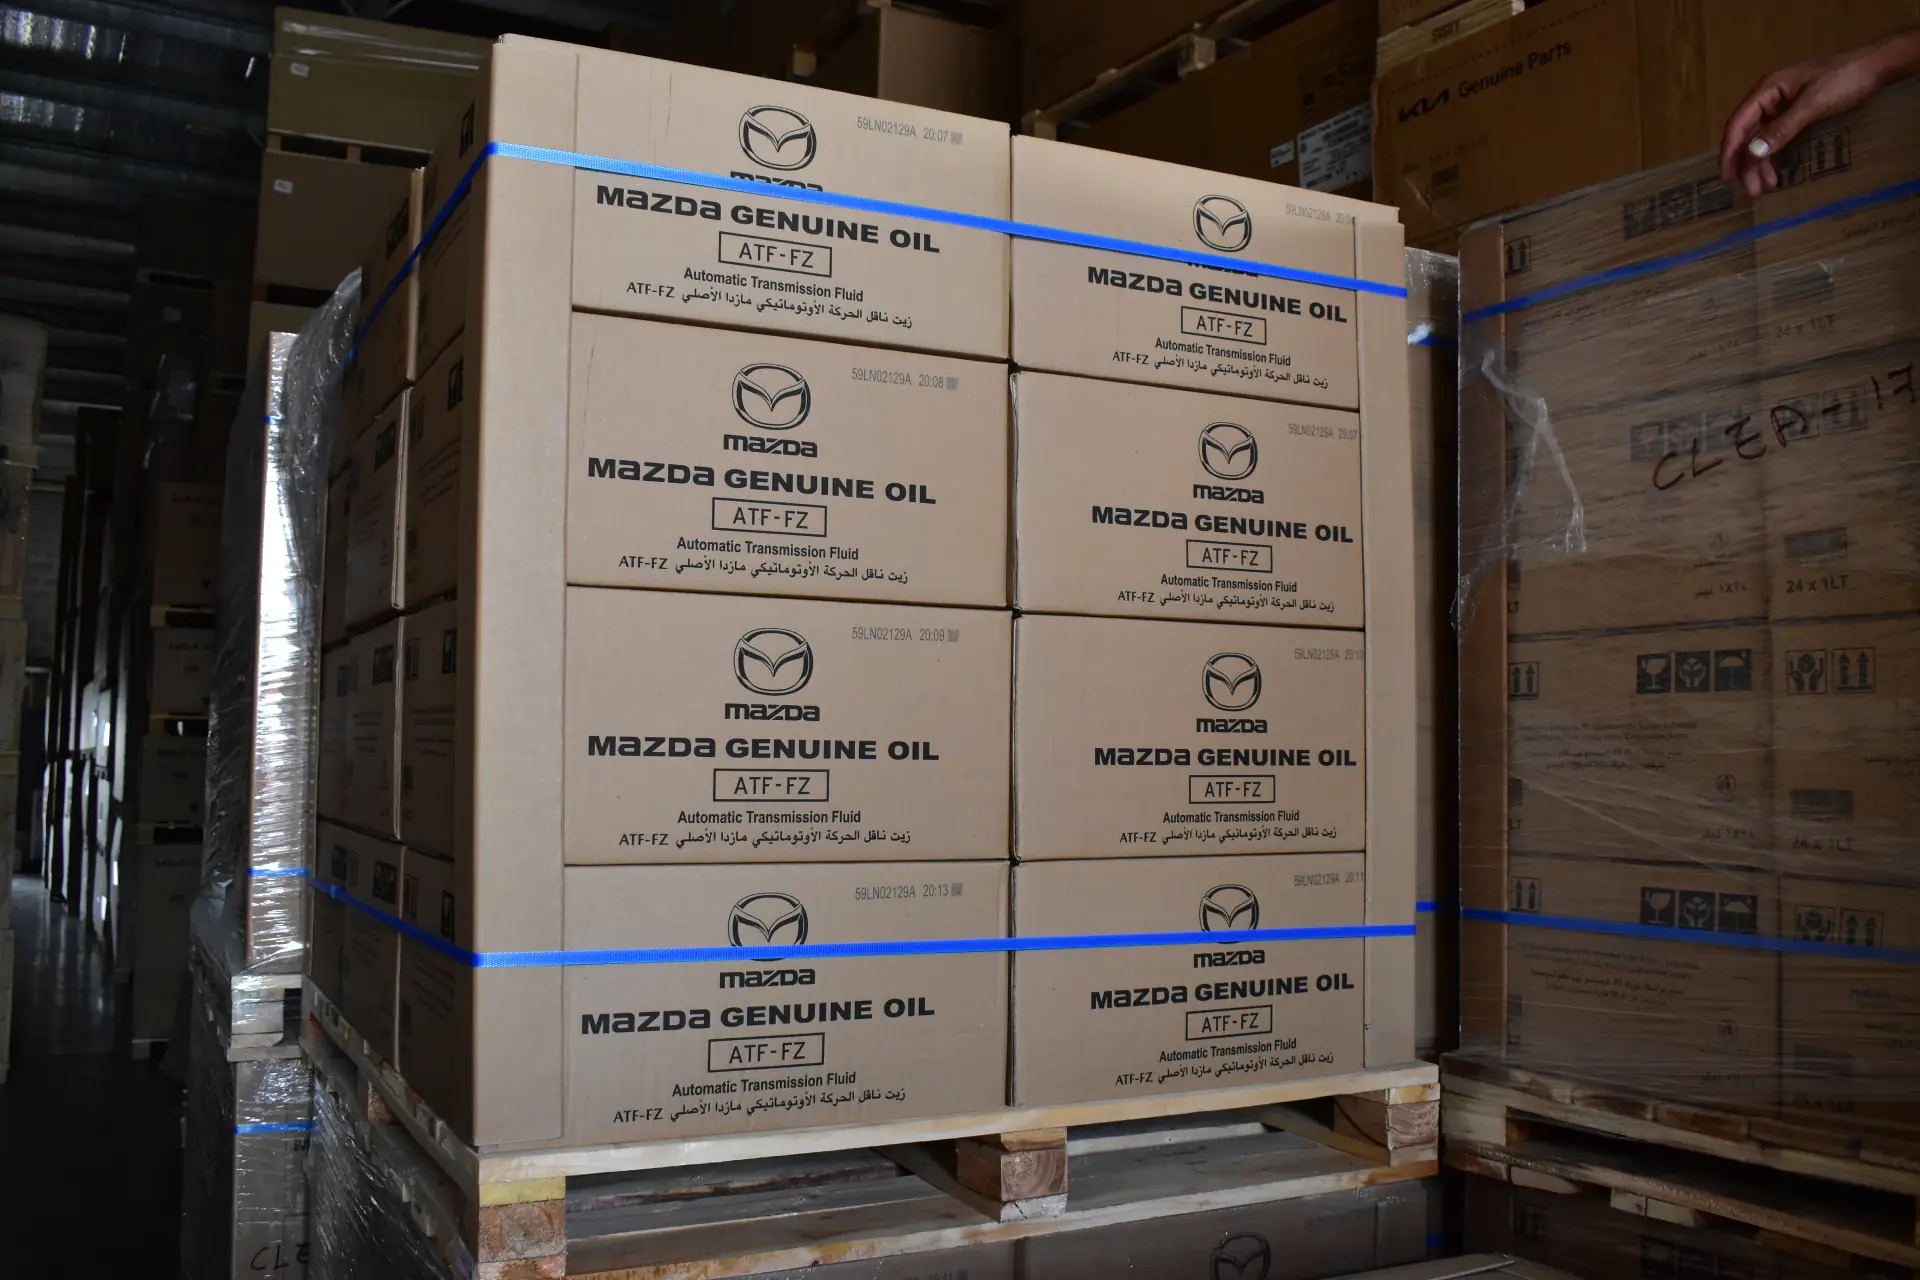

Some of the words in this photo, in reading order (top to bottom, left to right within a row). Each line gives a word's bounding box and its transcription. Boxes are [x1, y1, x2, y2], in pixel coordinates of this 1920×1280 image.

[1458, 62, 1523, 98] Genuine
[1528, 40, 1572, 69] Parts
[857, 116, 917, 138] 59LN02129A
[923, 127, 948, 142] 20:07
[731, 205, 879, 244] GENUINE
[890, 229, 940, 253] OIL
[739, 242, 814, 268] ATF-FZ
[626, 282, 675, 298] ATF-FZ
[684, 267, 747, 287] Automatic
[751, 276, 831, 298] Transmission
[835, 287, 863, 302] Fluid
[682, 286, 721, 304] الأصلي
[726, 292, 752, 307] مازدا
[1189, 283, 1301, 315] GENUINE
[1309, 302, 1347, 323] OIL
[828, 304, 862, 320] الحركة
[866, 311, 888, 323] ناقل
[892, 316, 912, 329] زيت
[1196, 315, 1253, 338] ATF-FZ
[1112, 351, 1149, 365] ATF-FZ
[1155, 337, 1203, 354] Automatic
[1206, 344, 1267, 363] Transmission
[1269, 353, 1291, 366] Fluid
[1154, 354, 1184, 369] الأصلي
[1187, 359, 1207, 372] مازدا
[852, 367, 912, 386] 59LN02129A
[918, 374, 944, 388] 20:08
[1265, 369, 1291, 383] الحركة
[1293, 374, 1310, 384] ناقل
[1313, 378, 1328, 389] زيت
[723, 434, 818, 458] mazda
[724, 469, 874, 499] GENUINE
[885, 483, 936, 504] OIL
[1193, 484, 1264, 504] mazda
[733, 507, 808, 529] ATF-FZ
[1194, 514, 1307, 539] GENUINE
[1315, 524, 1353, 543] OIL
[677, 536, 741, 553] Automatic
[745, 541, 826, 558] Transmission
[830, 546, 859, 560] Fluid
[619, 556, 668, 570] ATF-FZ
[675, 555, 715, 574] الأصلي
[1202, 547, 1259, 566] ATF-FZ
[720, 560, 746, 574] مازدا
[823, 565, 858, 580] الحركة
[861, 568, 884, 581] ناقل
[888, 572, 908, 584] زيت
[1161, 574, 1209, 587] Automatic
[1211, 577, 1273, 591] Transmission
[1275, 581, 1297, 592] Fluid
[1786, 580, 1803, 593] 24
[1823, 574, 1849, 591] 1LT
[1118, 591, 1155, 603] ATF-FZ
[1160, 589, 1190, 606] الأصلي
[1193, 593, 1213, 606] مازدا
[1271, 597, 1297, 610] الحركة
[1300, 600, 1316, 610] ناقل
[1319, 602, 1334, 613] زيت
[852, 626, 913, 641] 59LN02129A
[919, 628, 945, 642] 20:09
[725, 703, 820, 722] mazda
[1196, 718, 1267, 733] mazda
[725, 738, 877, 760] GENUINE
[888, 741, 939, 760] OIL
[1197, 749, 1311, 766] GENUINE
[1318, 749, 1357, 766] OIL
[734, 777, 810, 795] ATF-FZ
[1204, 781, 1261, 797] ATF-FZ
[677, 810, 742, 824] Automatic
[746, 810, 828, 823] Transmission
[832, 810, 861, 823] Fluid
[1163, 812, 1211, 823] Automatic
[1214, 810, 1275, 822] Transmission
[1278, 810, 1300, 821] Fluid
[619, 833, 668, 846] ATF-FZ
[676, 828, 716, 849] الأصلي
[721, 831, 747, 846] مازدا
[825, 829, 860, 845] الحركة
[864, 830, 886, 843] ناقل
[890, 831, 911, 844] زيت
[1120, 832, 1156, 843] ATF-FZ
[1162, 827, 1192, 845] الأصلي
[1195, 829, 1216, 842] مازدا
[1273, 827, 1299, 840] الحركة
[1302, 827, 1319, 838] ناقل
[1321, 827, 1337, 839] زيت
[855, 885, 916, 901] 59LN02129A
[923, 884, 949, 897] 20:13
[1194, 949, 1265, 968] mazda
[719, 968, 816, 989] mazda
[1195, 976, 1308, 1001] GENUINE
[1316, 973, 1354, 992] OIL
[720, 1000, 872, 1027] GENUINE
[884, 997, 935, 1018] OIL
[1201, 1012, 1259, 1033] ATF-FZ
[729, 1041, 805, 1064] ATF-FZ
[1159, 1047, 1208, 1063] Automatic
[1210, 1041, 1272, 1059] Transmission
[1274, 1038, 1297, 1051] Fluid
[1318, 1052, 1334, 1064] زيت
[1270, 1056, 1296, 1069] الحركة
[1298, 1053, 1316, 1066] ناقل
[1116, 1072, 1153, 1085] ATF-FZ
[1158, 1064, 1188, 1084] الأصلي
[1191, 1065, 1212, 1078] مازدا
[672, 1080, 737, 1097] Automatic
[740, 1075, 823, 1094] Transmission
[827, 1071, 856, 1085] Fluid
[820, 1091, 855, 1107] الحركة
[858, 1090, 881, 1103] ناقل
[885, 1088, 906, 1101] زيت
[613, 1108, 663, 1123] ATF-FZ
[670, 1099, 711, 1122] الأصلي
[715, 1100, 742, 1115] مازدا
